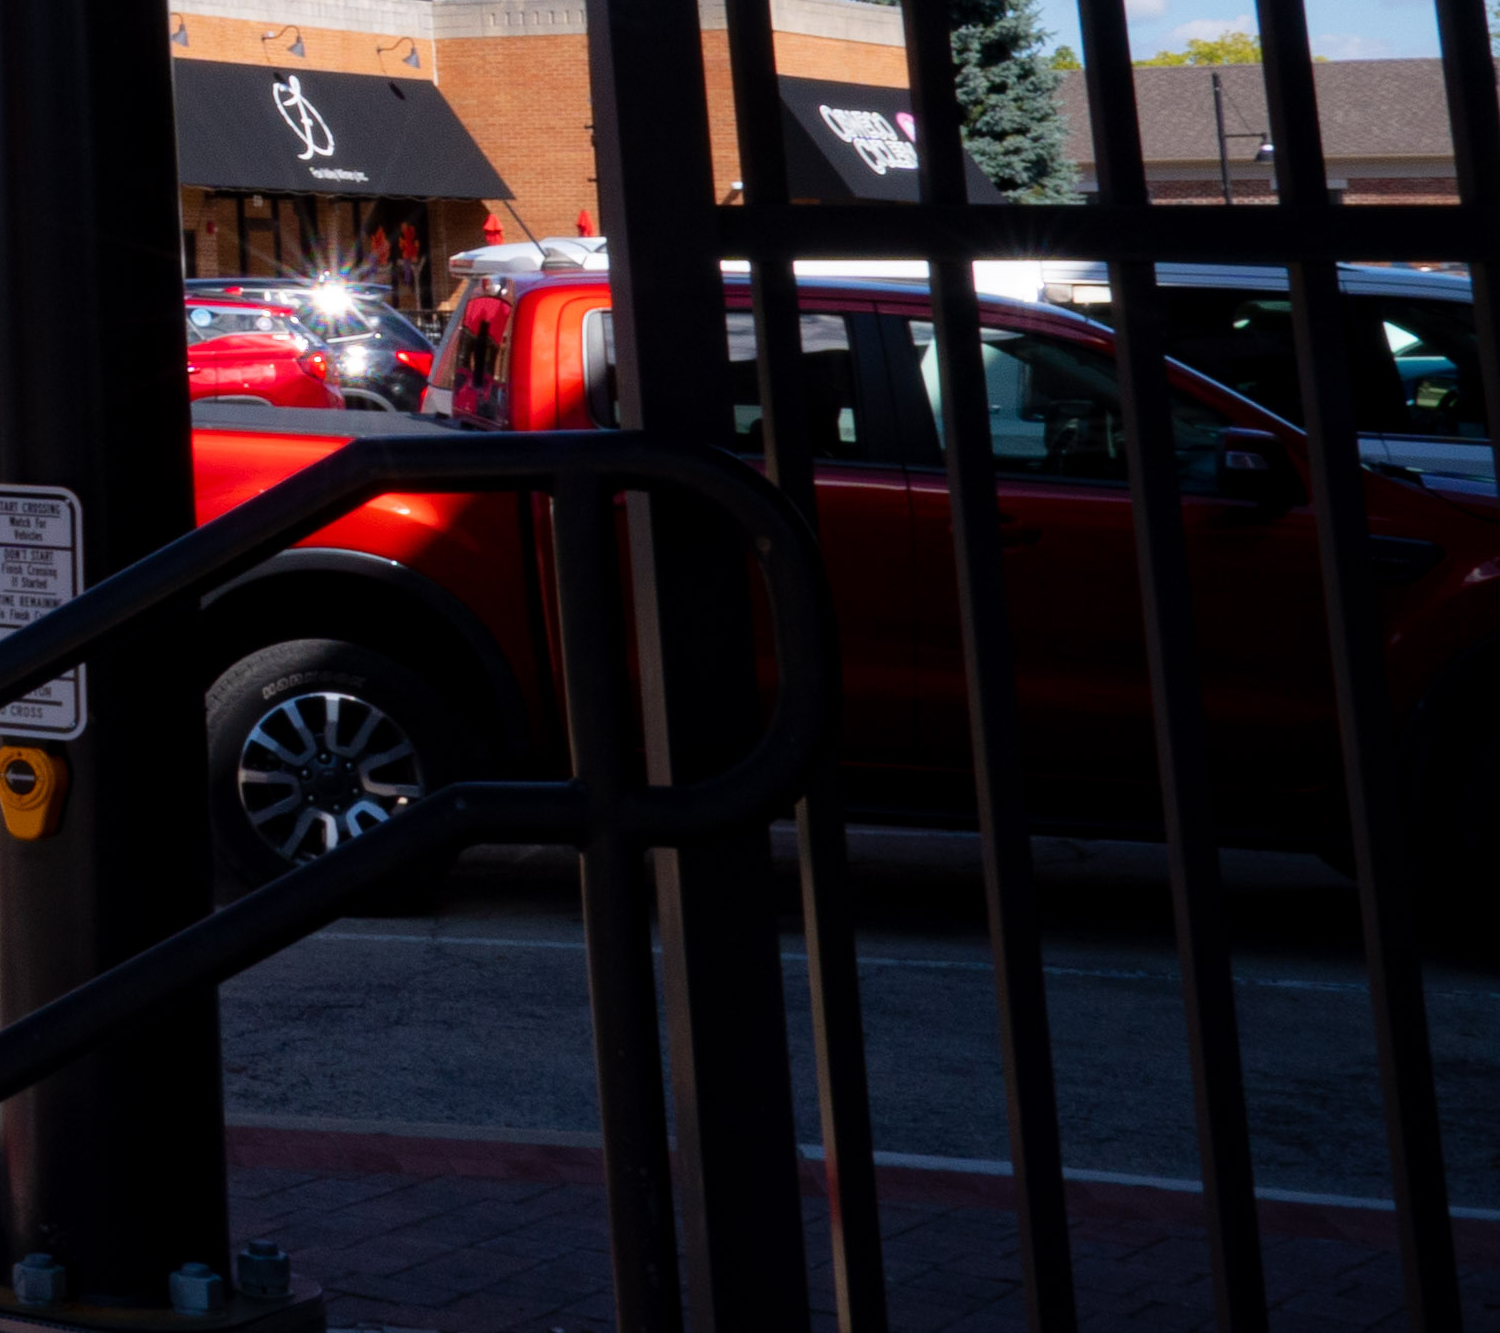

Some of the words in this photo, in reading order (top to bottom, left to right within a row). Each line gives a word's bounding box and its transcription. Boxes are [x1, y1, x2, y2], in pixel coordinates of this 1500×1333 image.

[22, 502, 60, 514] CROSSING
[10, 517, 31, 528] Watch
[14, 530, 43, 541] Vehicles
[4, 548, 26, 560] DON'T
[31, 550, 54, 561] START
[2, 562, 23, 574] Finish
[27, 564, 58, 579] Crossing
[22, 577, 47, 589] Started
[11, 705, 43, 718] CROSS
